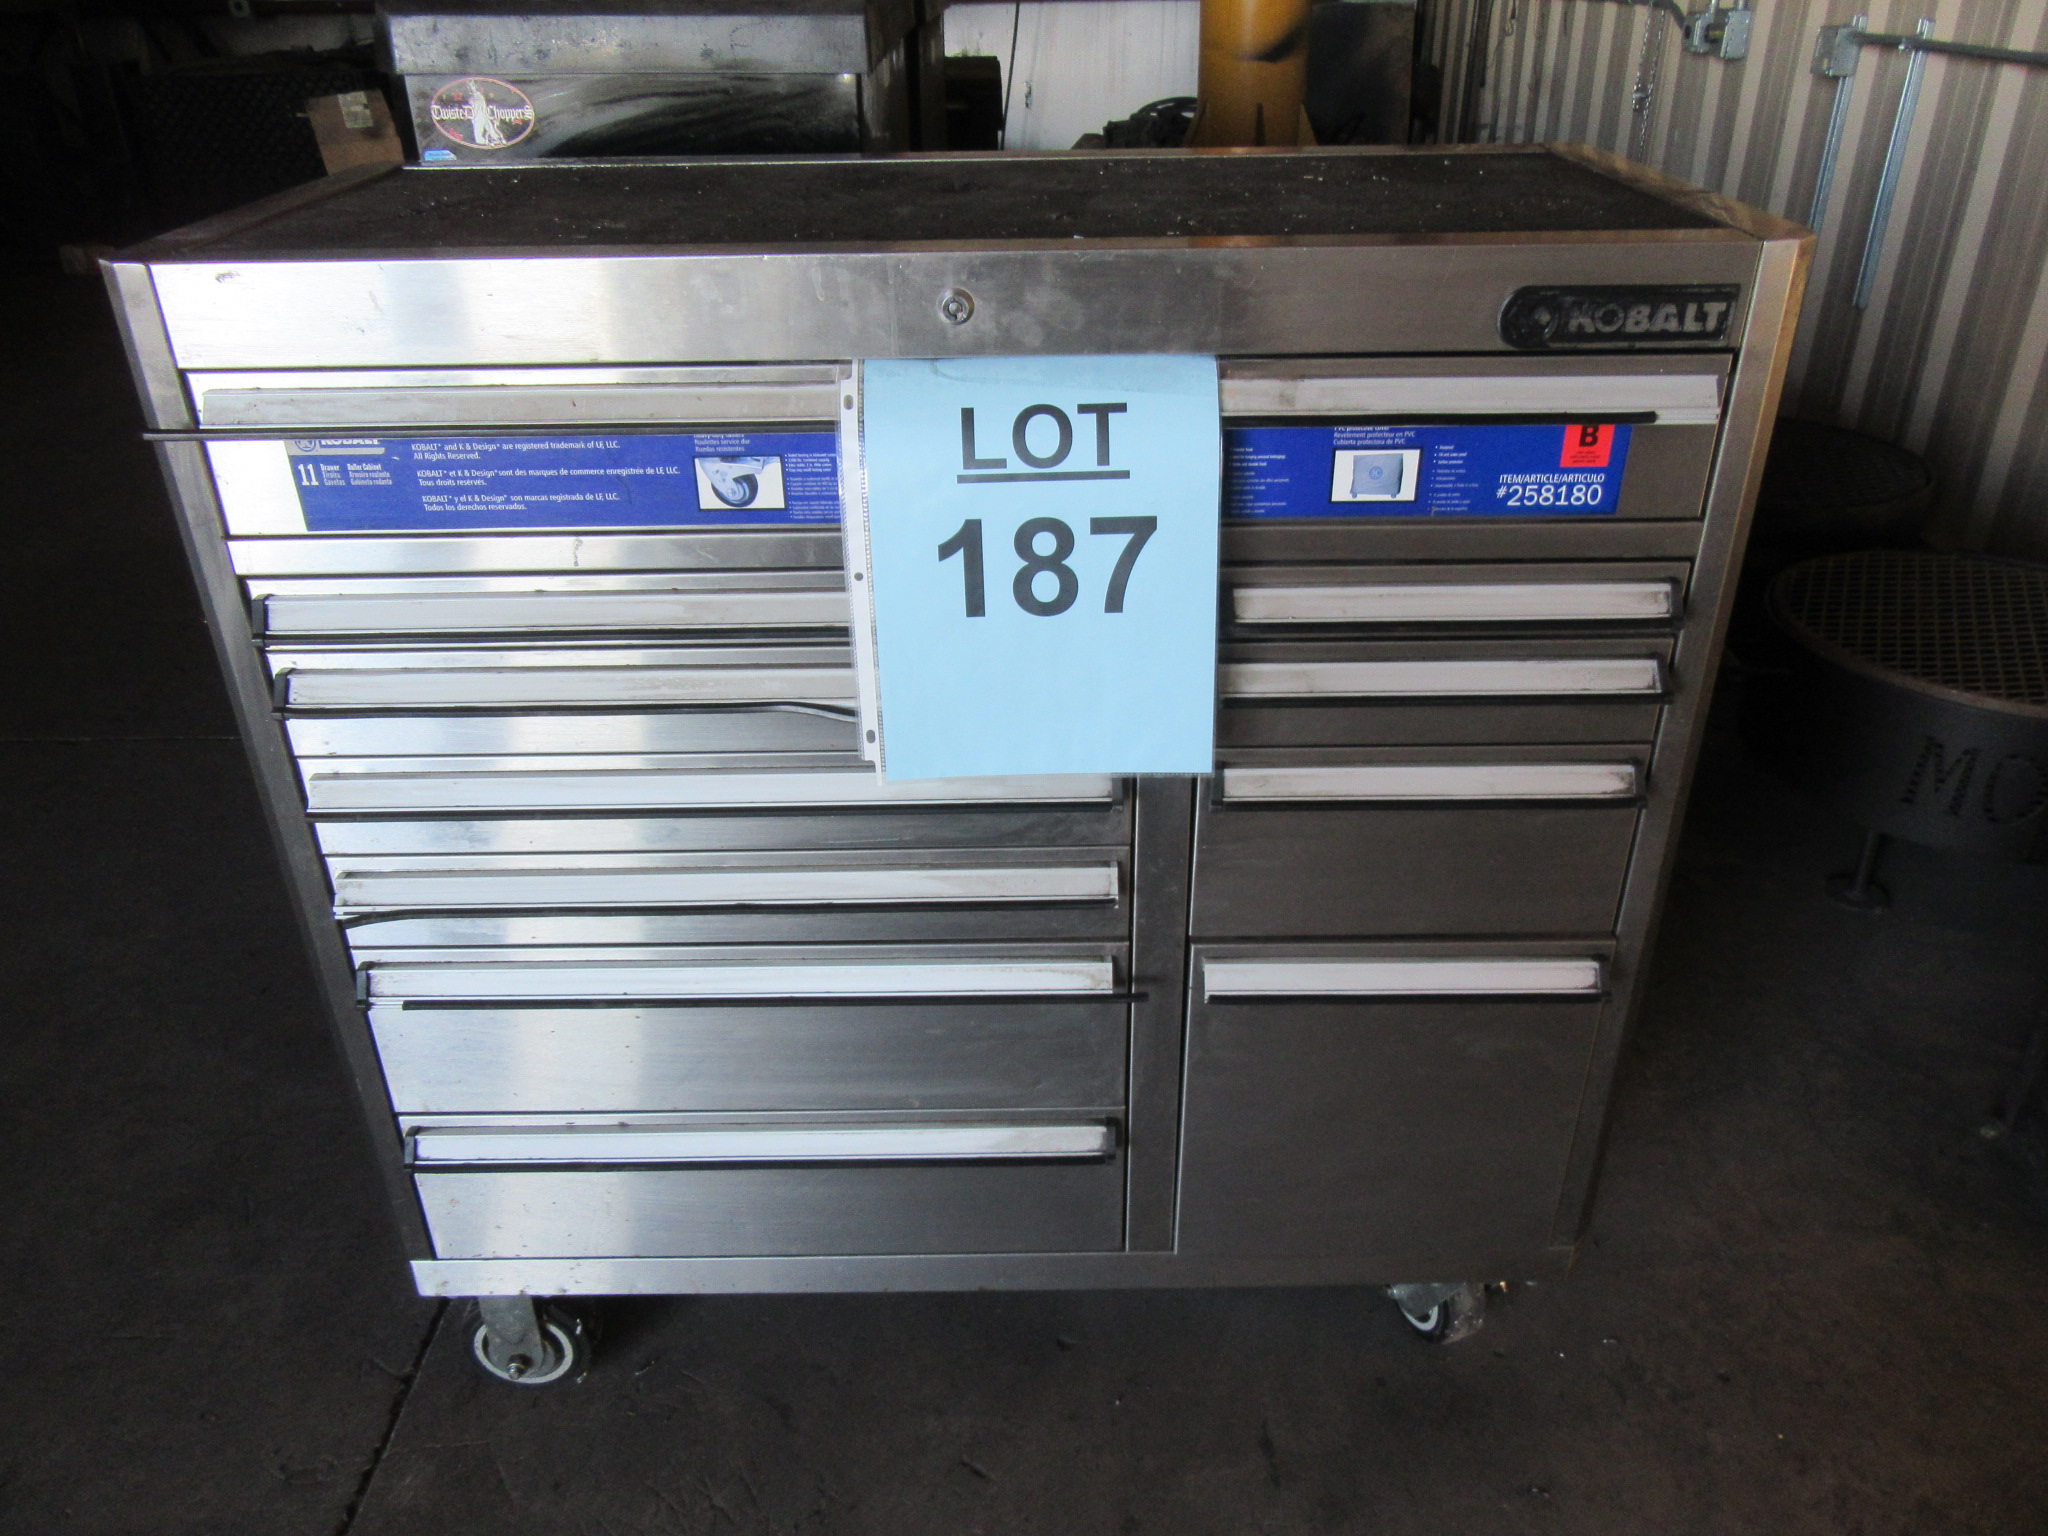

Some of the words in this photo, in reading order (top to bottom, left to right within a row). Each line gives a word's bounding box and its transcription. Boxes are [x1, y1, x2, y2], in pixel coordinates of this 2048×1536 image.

[1567, 301, 1728, 334] KOBALT
[960, 402, 1128, 471] LOT
[1579, 424, 1599, 447] B
[515, 441, 549, 451] registered
[550, 441, 586, 449] trademark
[587, 440, 594, 449] of
[606, 440, 621, 449] LLC.
[413, 452, 423, 460] All
[424, 452, 446, 461] Rights
[297, 463, 319, 486] 11
[529, 469, 558, 477] marques
[645, 467, 654, 475] de
[666, 466, 680, 474] LLC.
[436, 478, 455, 486] droits
[549, 493, 584, 502] registrada
[1496, 484, 1602, 506] #258180
[445, 503, 455, 511] los
[456, 503, 487, 511] derechos
[489, 502, 527, 510] reservados.
[937, 515, 1158, 618] 187
